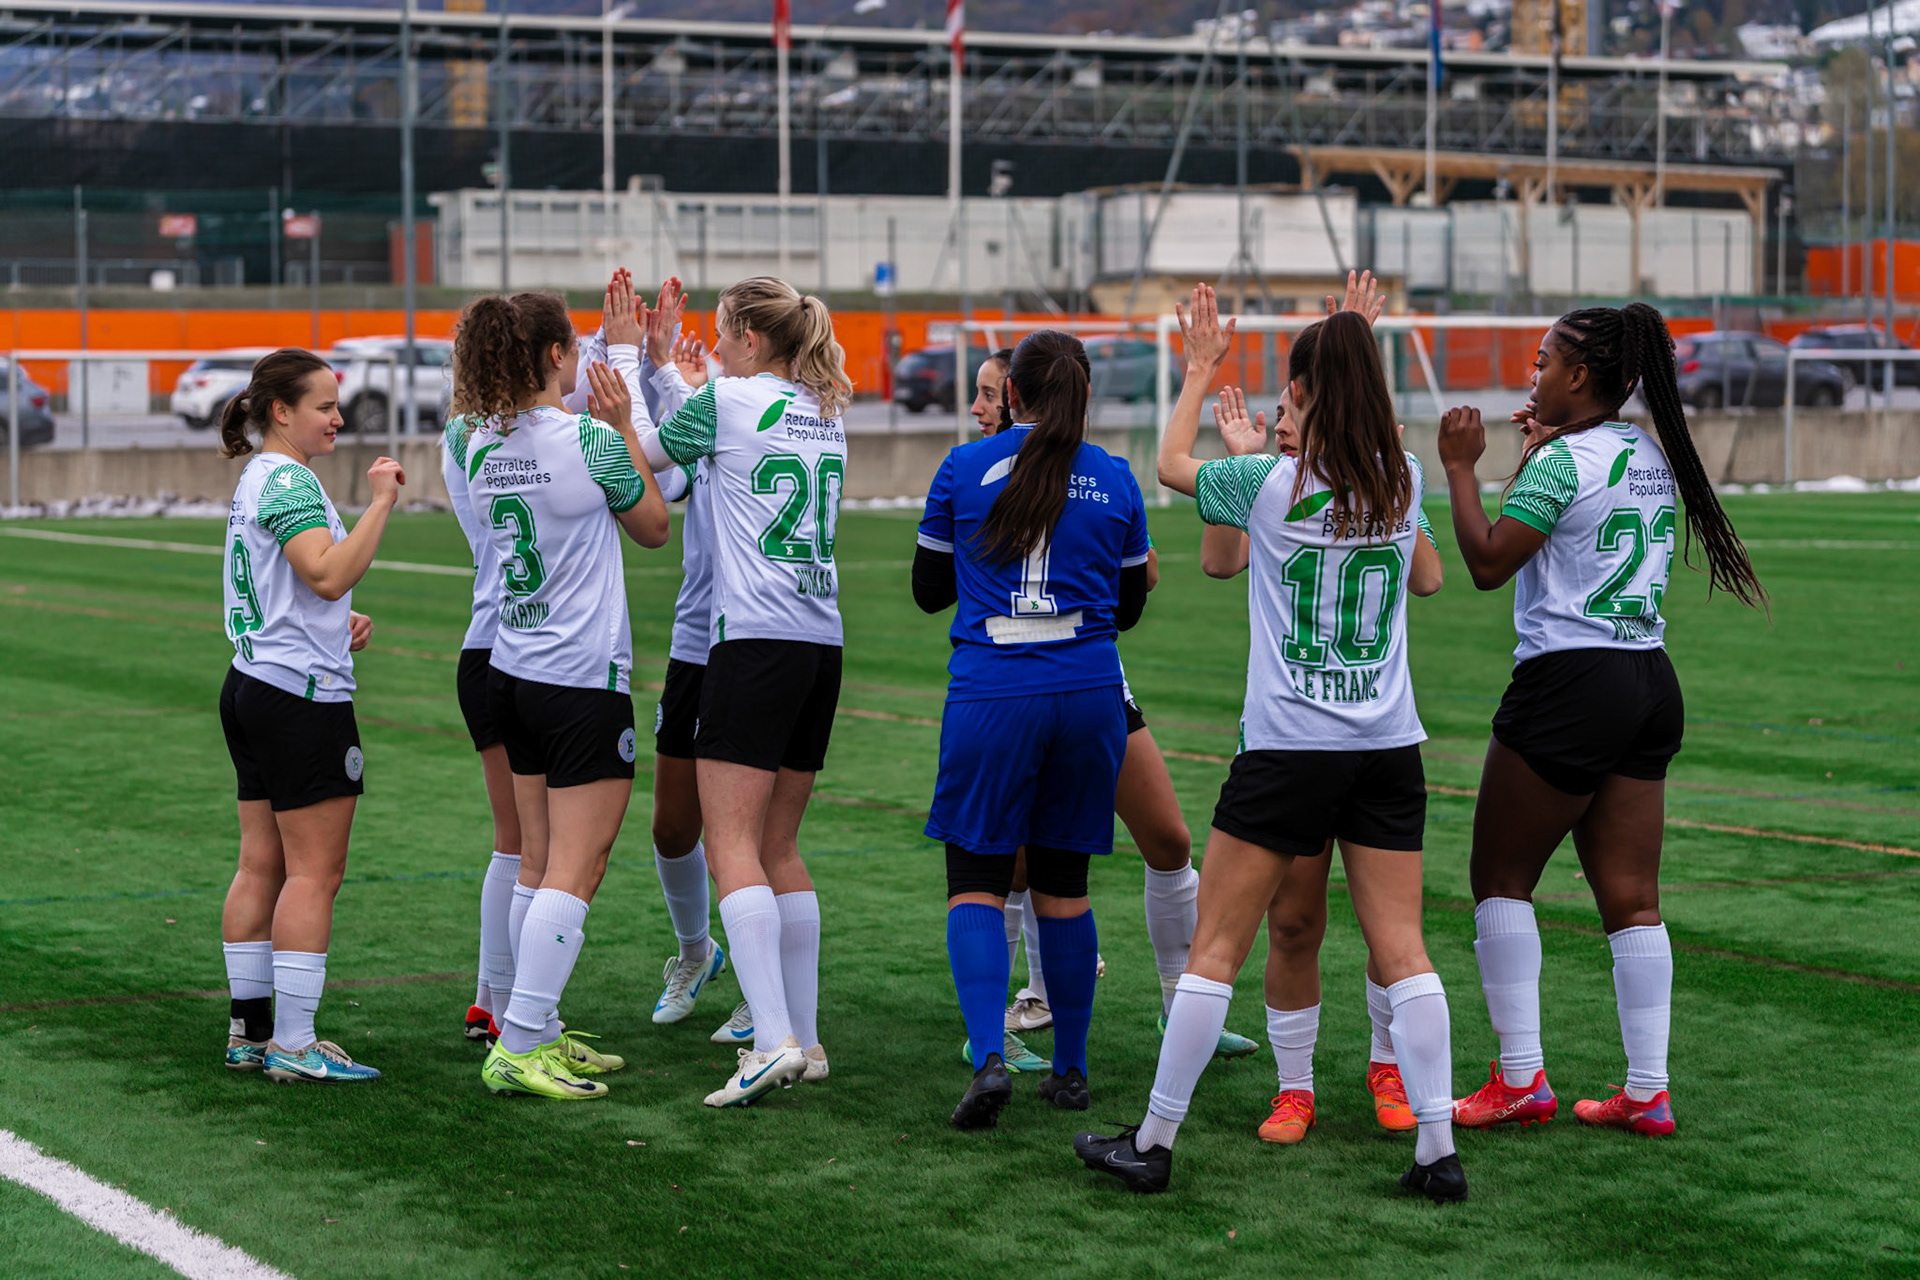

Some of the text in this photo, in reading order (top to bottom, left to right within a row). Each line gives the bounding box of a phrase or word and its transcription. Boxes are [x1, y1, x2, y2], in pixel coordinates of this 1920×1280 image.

[785, 413, 836, 428] Retraites
[786, 427, 845, 442] Populaires
[484, 458, 537, 475] Retraites
[1627, 466, 1672, 481] Retraites
[485, 472, 551, 489] Populaires
[1629, 481, 1676, 499] Populaire
[1067, 486, 1109, 504] aires
[751, 453, 845, 563] 20
[489, 493, 547, 597] 3
[1583, 505, 1676, 621] 23
[226, 534, 264, 638] 9
[1281, 542, 1406, 668] 10
[1321, 667, 1381, 703] FRANC
[1494, 1093, 1535, 1119] ULTRA
